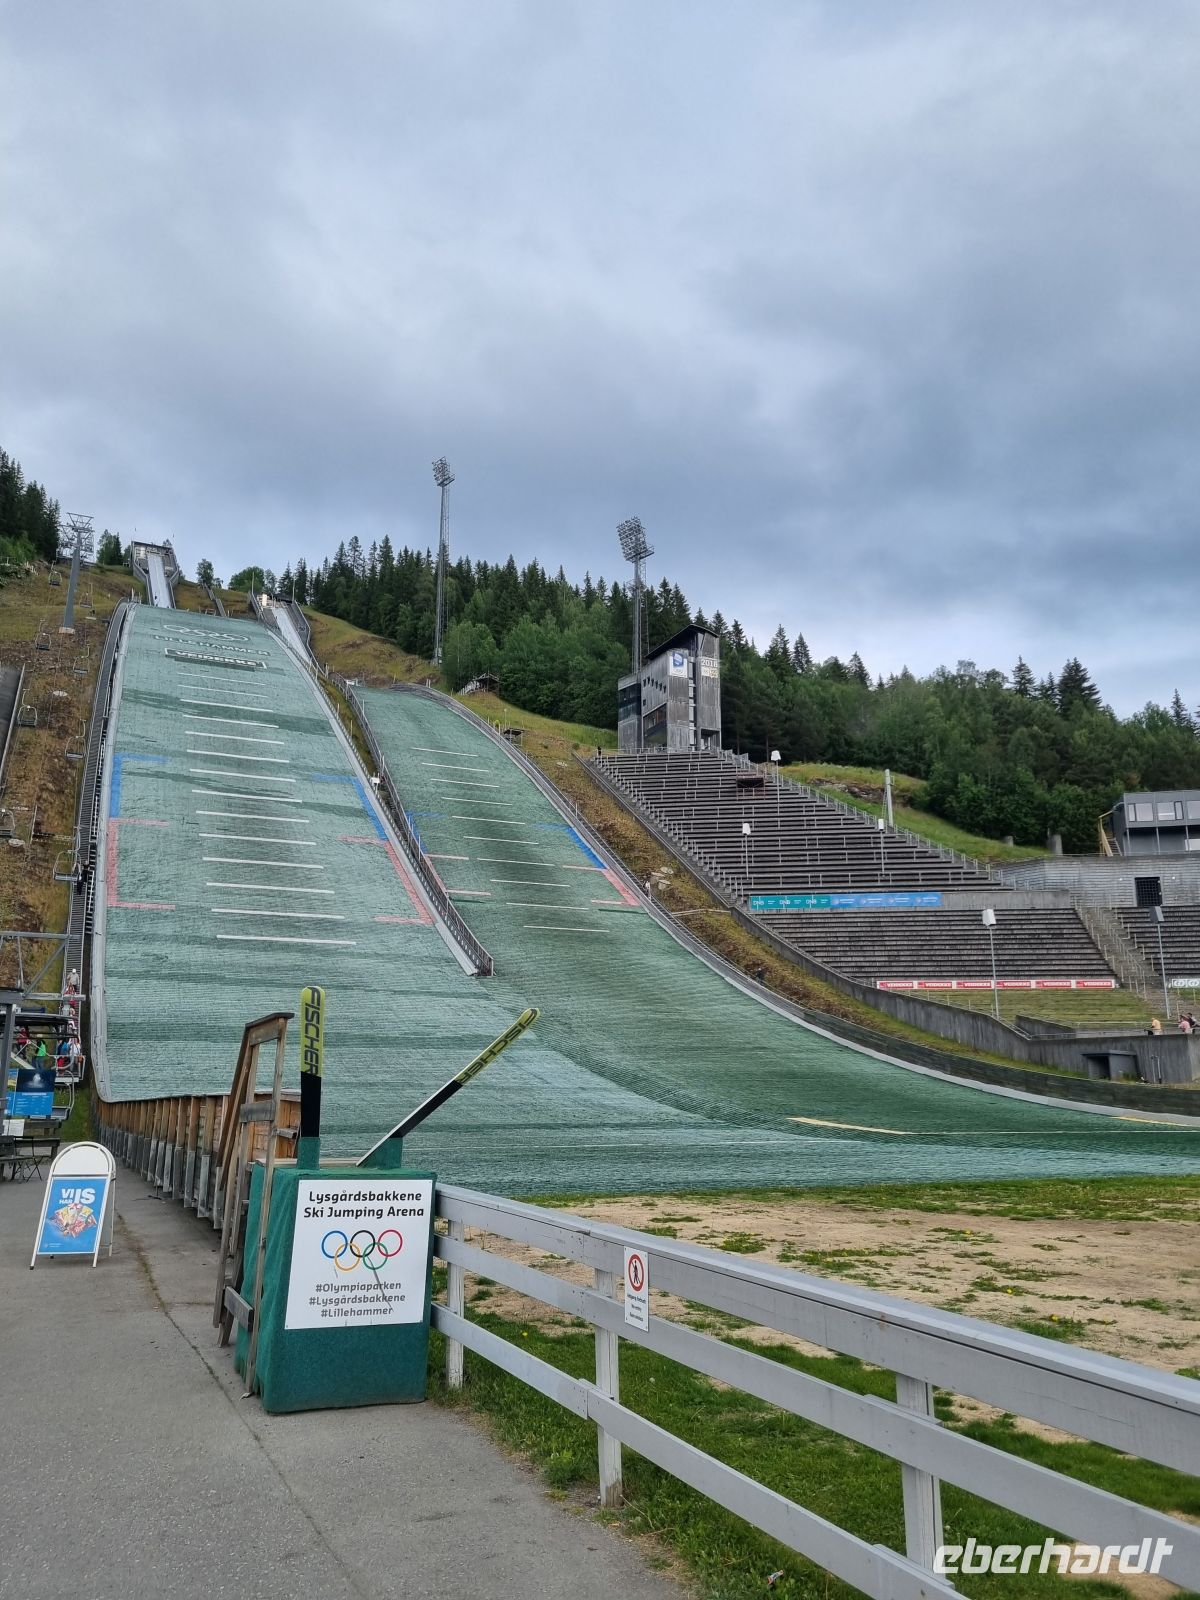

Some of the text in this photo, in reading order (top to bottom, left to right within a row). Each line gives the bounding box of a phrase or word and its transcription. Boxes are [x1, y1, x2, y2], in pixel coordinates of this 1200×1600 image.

[304, 986, 321, 1075] FISCHER
[457, 1008, 537, 1084] FISCHER
[61, 1188, 74, 1198] VI
[73, 1188, 96, 1204] IS
[309, 1189, 422, 1204] Lysgårdsbakkene
[304, 1206, 424, 1219] Ski Jumping Arena
[315, 1281, 402, 1293] #Olympiaparken
[308, 1294, 406, 1307] #Lysgårdsbakkene
[320, 1307, 393, 1318] #Lillehammer
